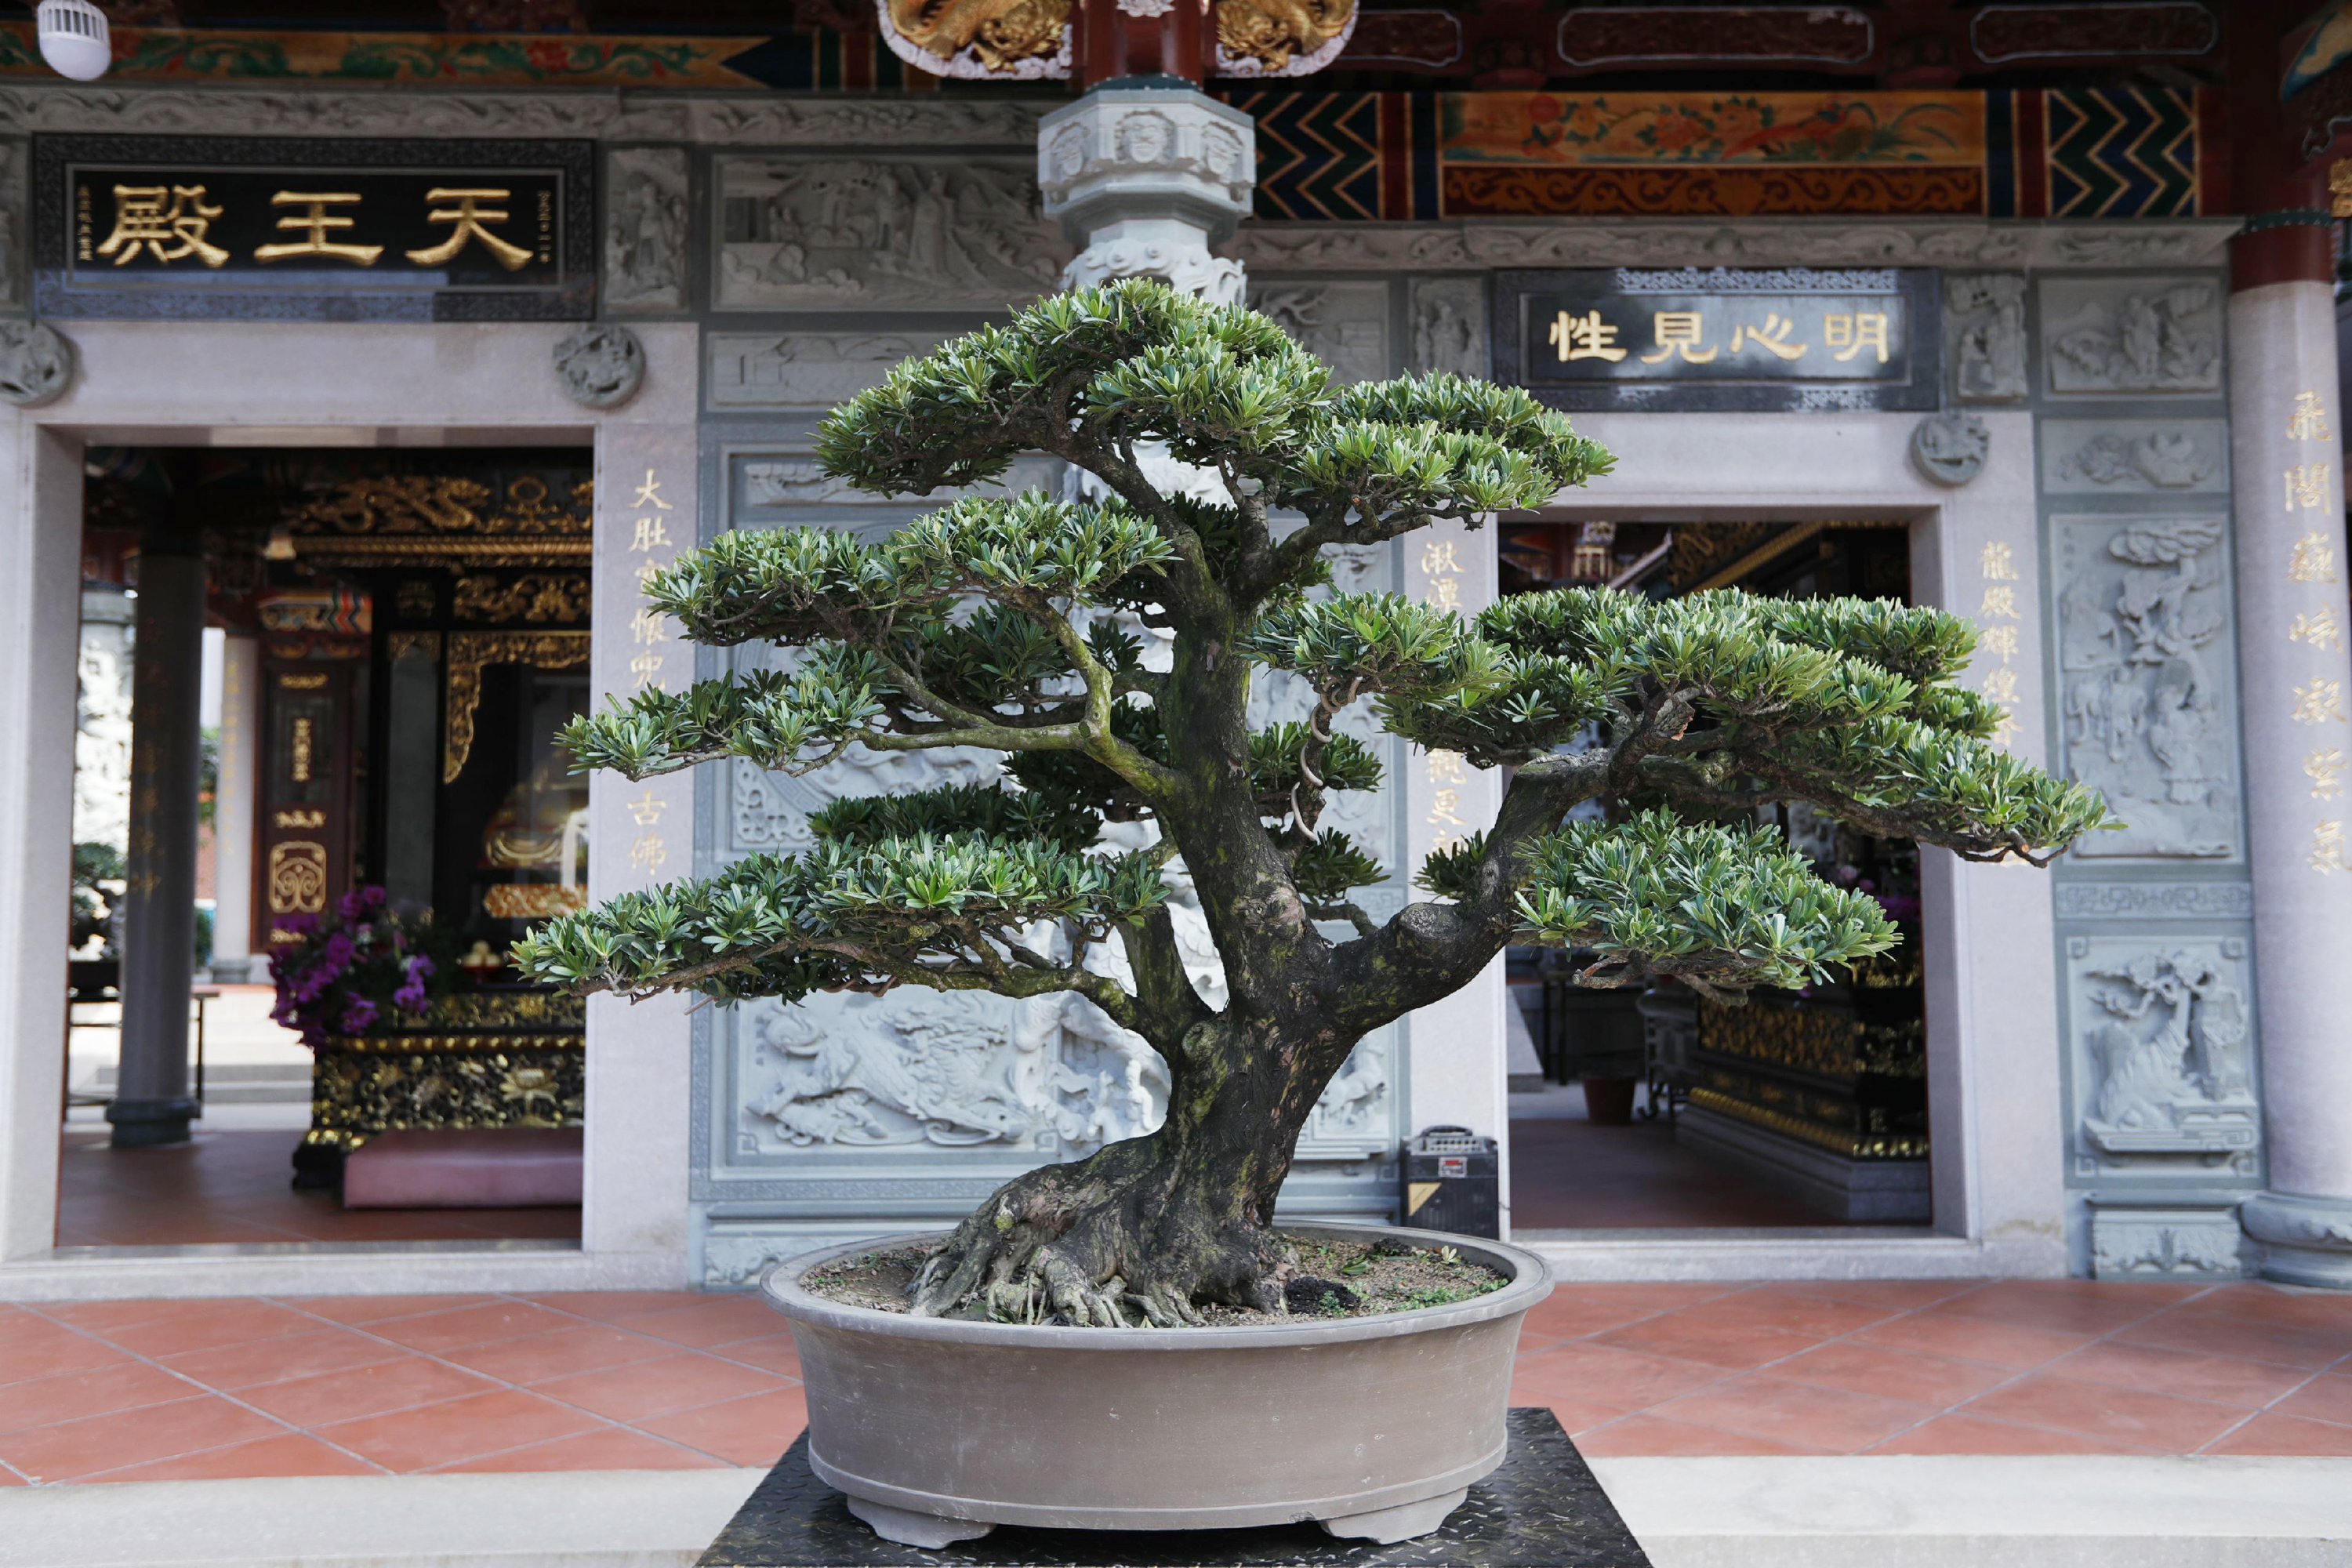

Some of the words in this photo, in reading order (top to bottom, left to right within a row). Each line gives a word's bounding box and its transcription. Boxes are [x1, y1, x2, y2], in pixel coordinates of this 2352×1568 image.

[97, 183, 534, 270] 天王殿
[1548, 309, 1889, 365] 明心見性
